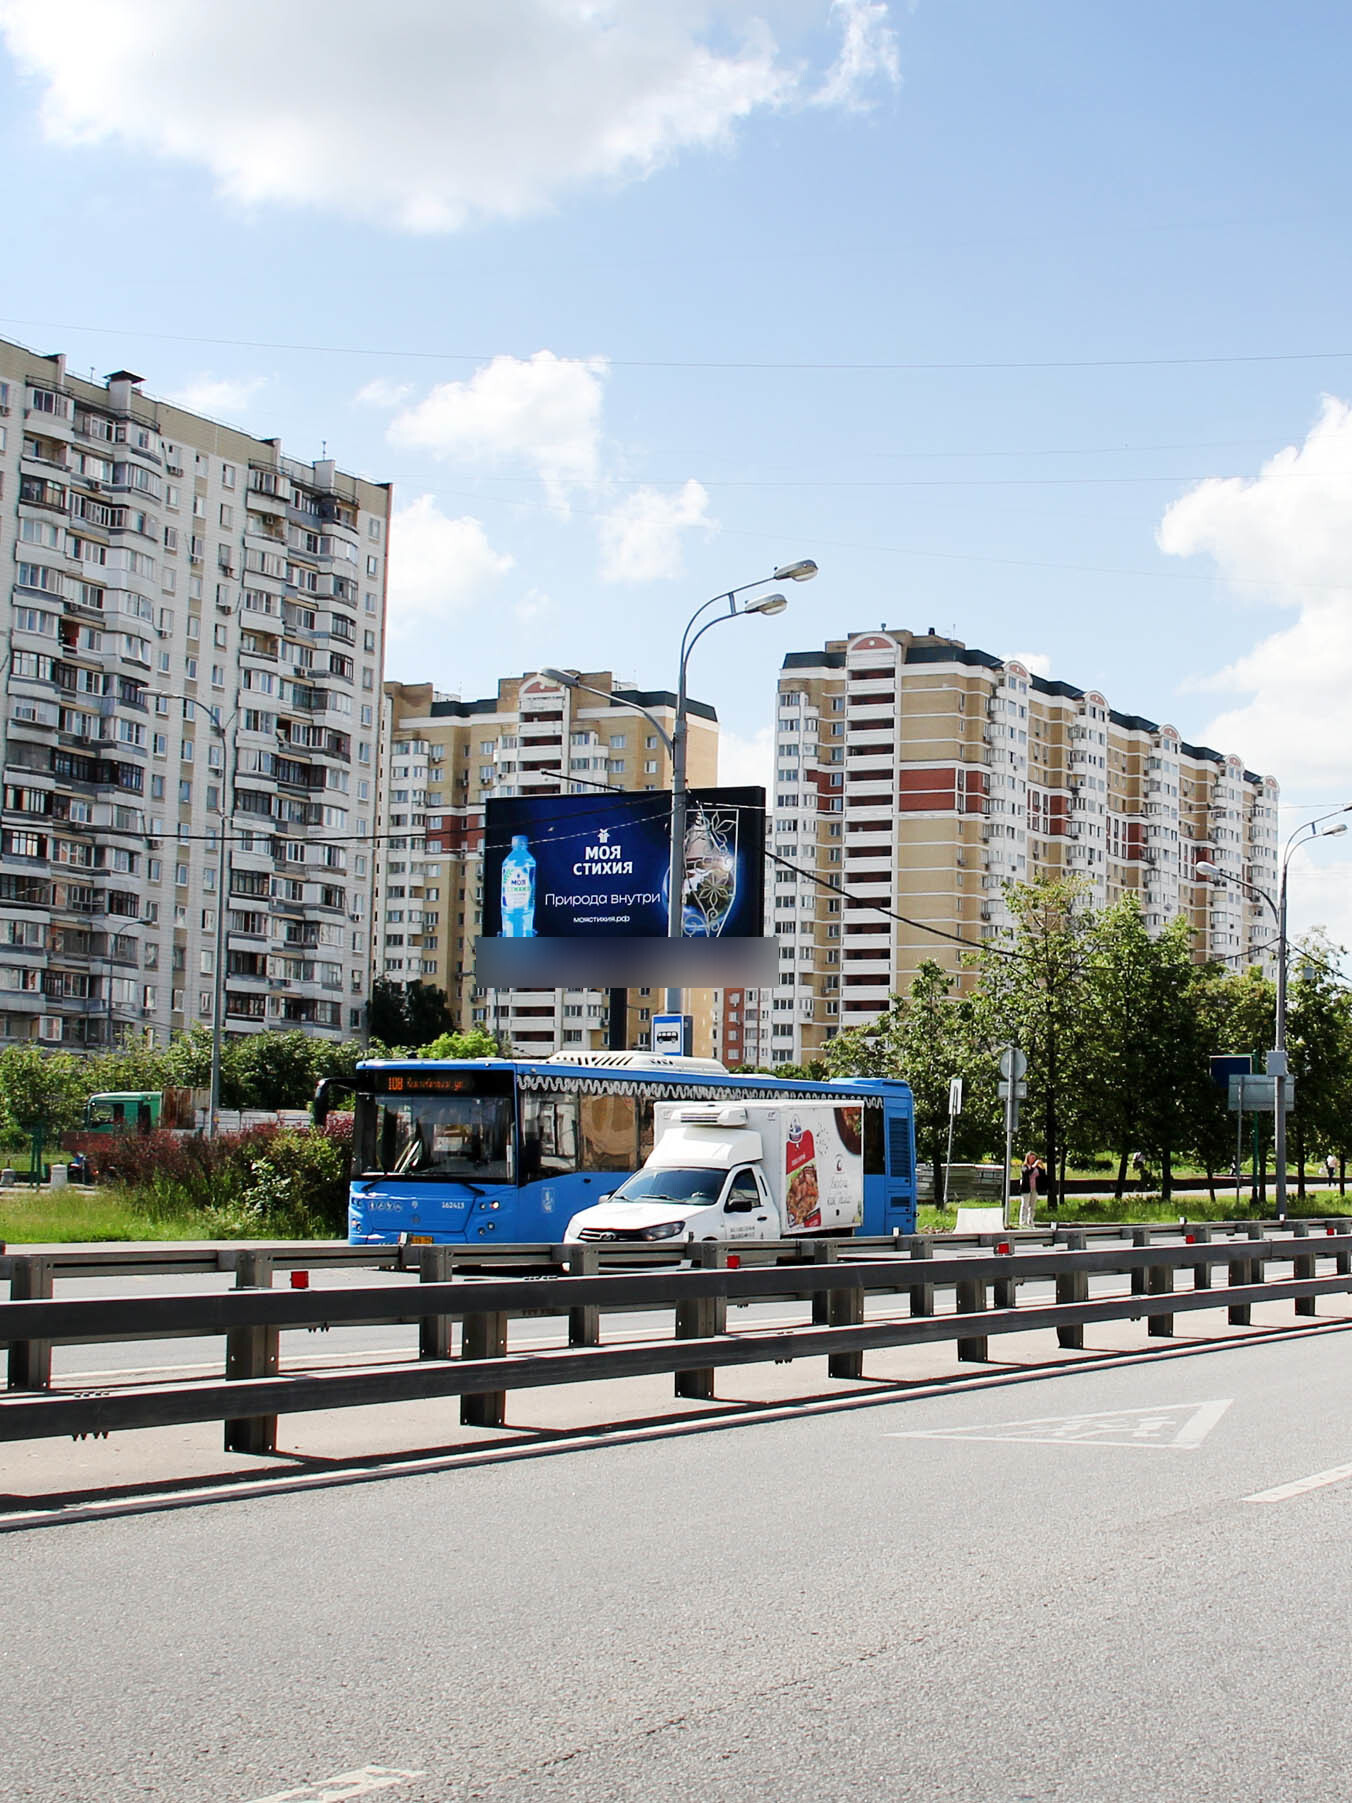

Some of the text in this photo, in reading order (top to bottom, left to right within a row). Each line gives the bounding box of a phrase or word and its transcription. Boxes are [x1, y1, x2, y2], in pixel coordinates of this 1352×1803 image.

[585, 845, 622, 860] МОЯ
[573, 861, 633, 875] СТИХИЯ
[544, 893, 661, 907] Природа внутри
